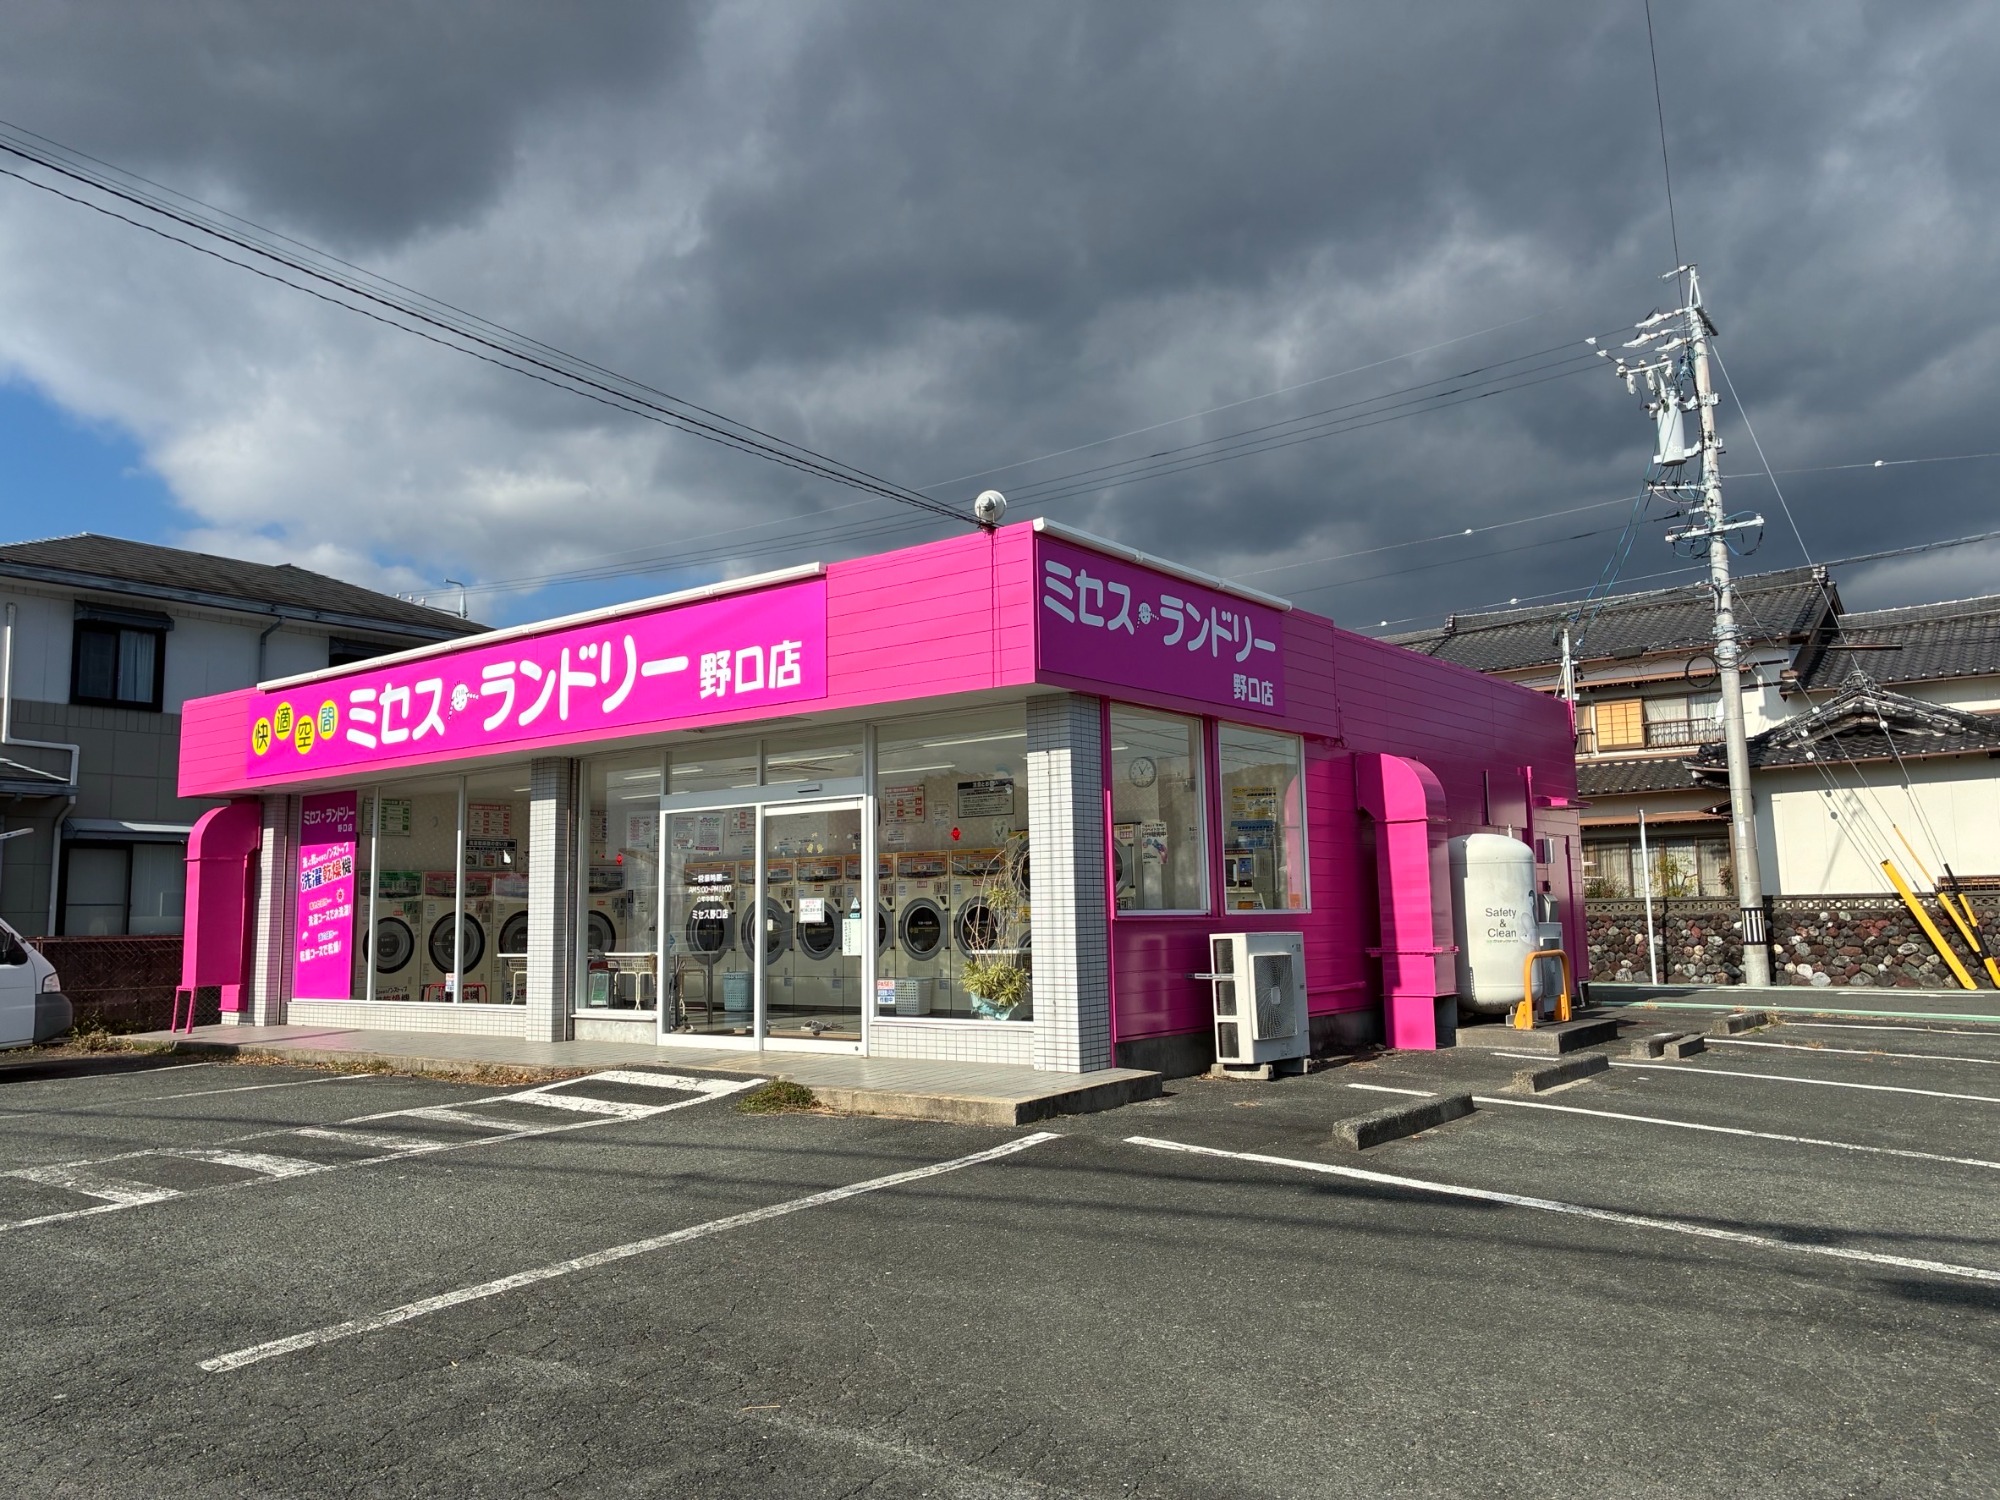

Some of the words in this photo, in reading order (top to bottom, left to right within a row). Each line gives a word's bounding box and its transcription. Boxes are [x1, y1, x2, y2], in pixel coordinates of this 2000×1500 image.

[1043, 559, 1135, 636] ミセス
[1159, 594, 1276, 663] ランドリー
[255, 705, 336, 751] 快適空間
[346, 677, 446, 750] ミセス
[480, 634, 689, 732] ランドリー
[699, 639, 803, 700] 野口店
[1233, 673, 1274, 707] 野口店
[301, 856, 352, 891] 洗濯乾燥機
[692, 909, 729, 920] ミセス野口店
[1485, 907, 1517, 919] Safety
[1499, 918, 1507, 928] &
[1487, 928, 1517, 938] Clean
